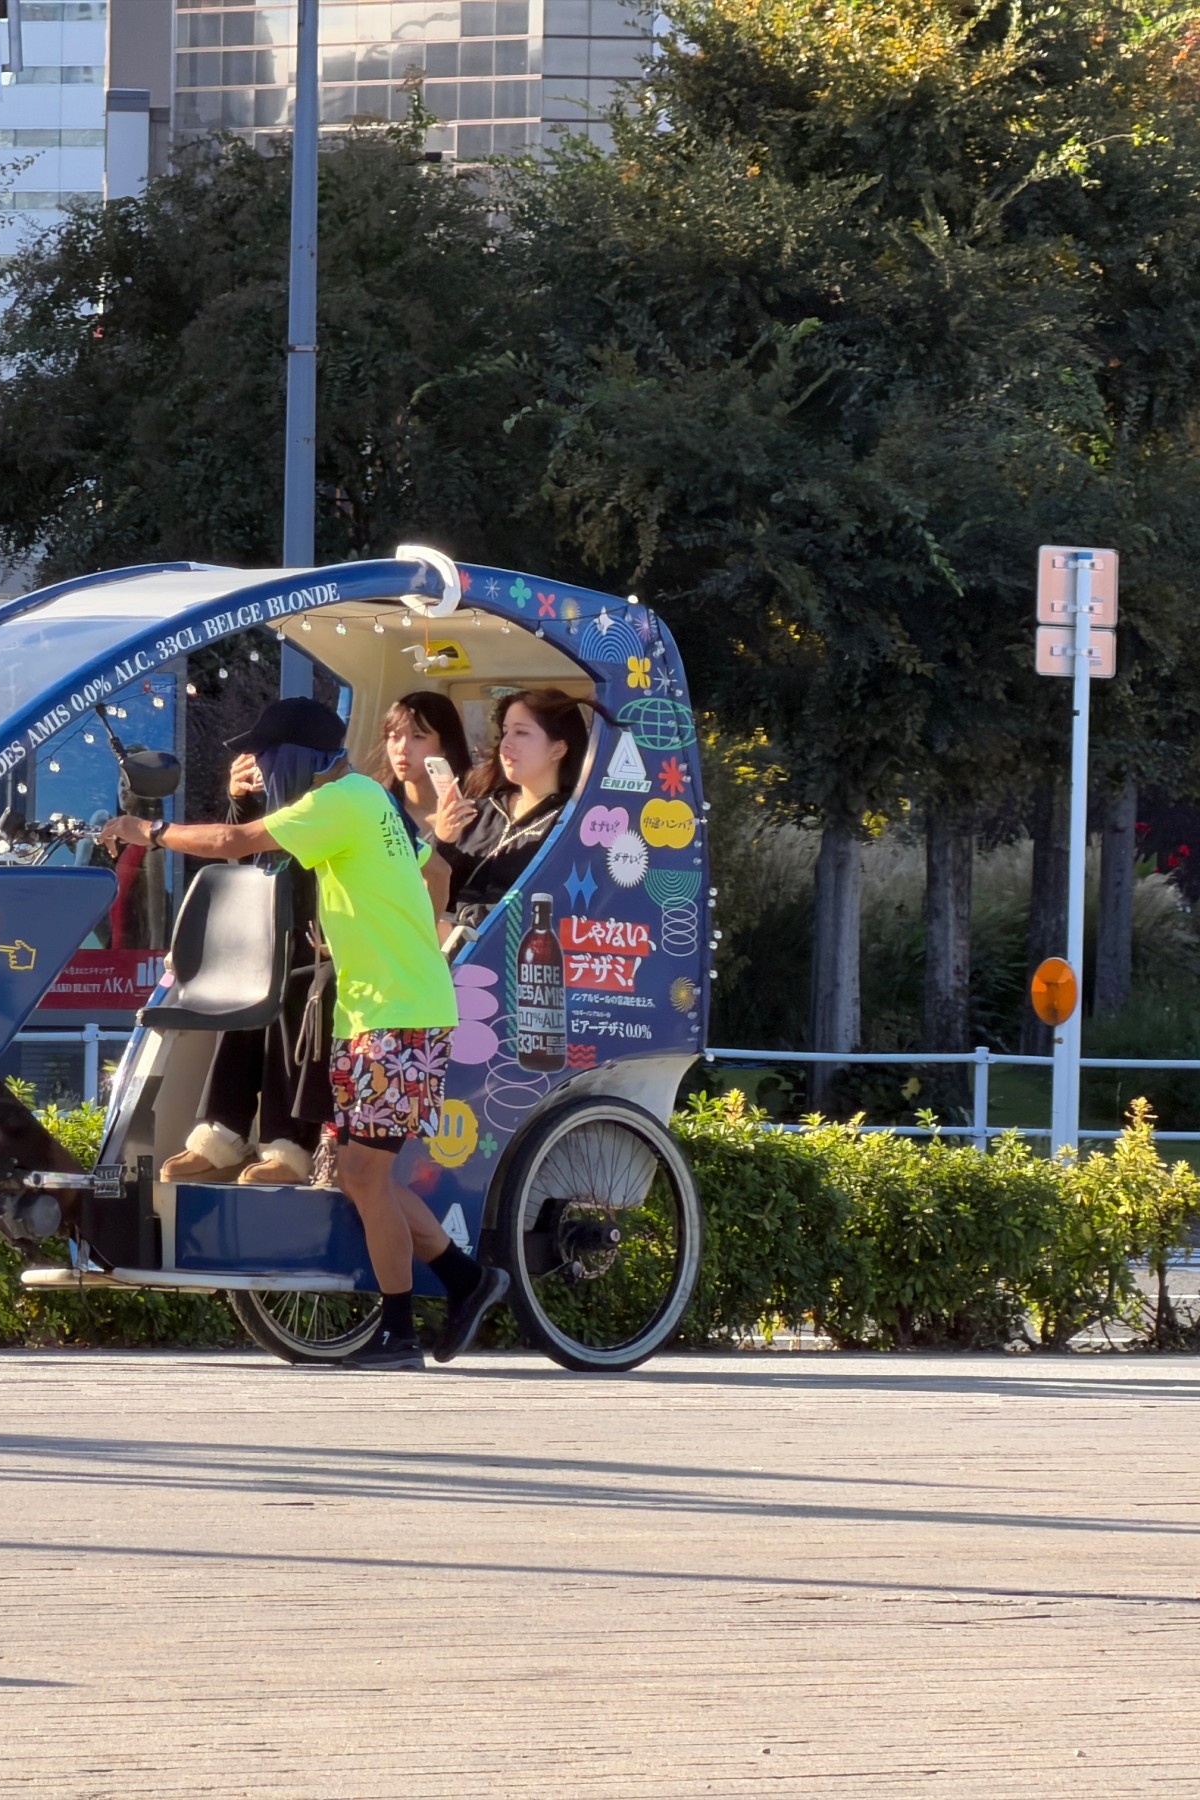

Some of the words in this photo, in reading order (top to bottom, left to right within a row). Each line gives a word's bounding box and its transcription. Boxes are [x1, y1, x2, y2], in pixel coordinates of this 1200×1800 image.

[27, 704, 72, 749] AMIS
[70, 675, 112, 712] 0.0%
[114, 651, 155, 685] ALC.
[155, 627, 202, 660] 33CL
[202, 602, 264, 640] BELGE
[265, 582, 341, 618] BLONDE
[602, 777, 650, 792] ENJOY!
[570, 914, 657, 952] じゃない、
[520, 963, 561, 984] BIERE
[569, 952, 642, 987] デザミ!
